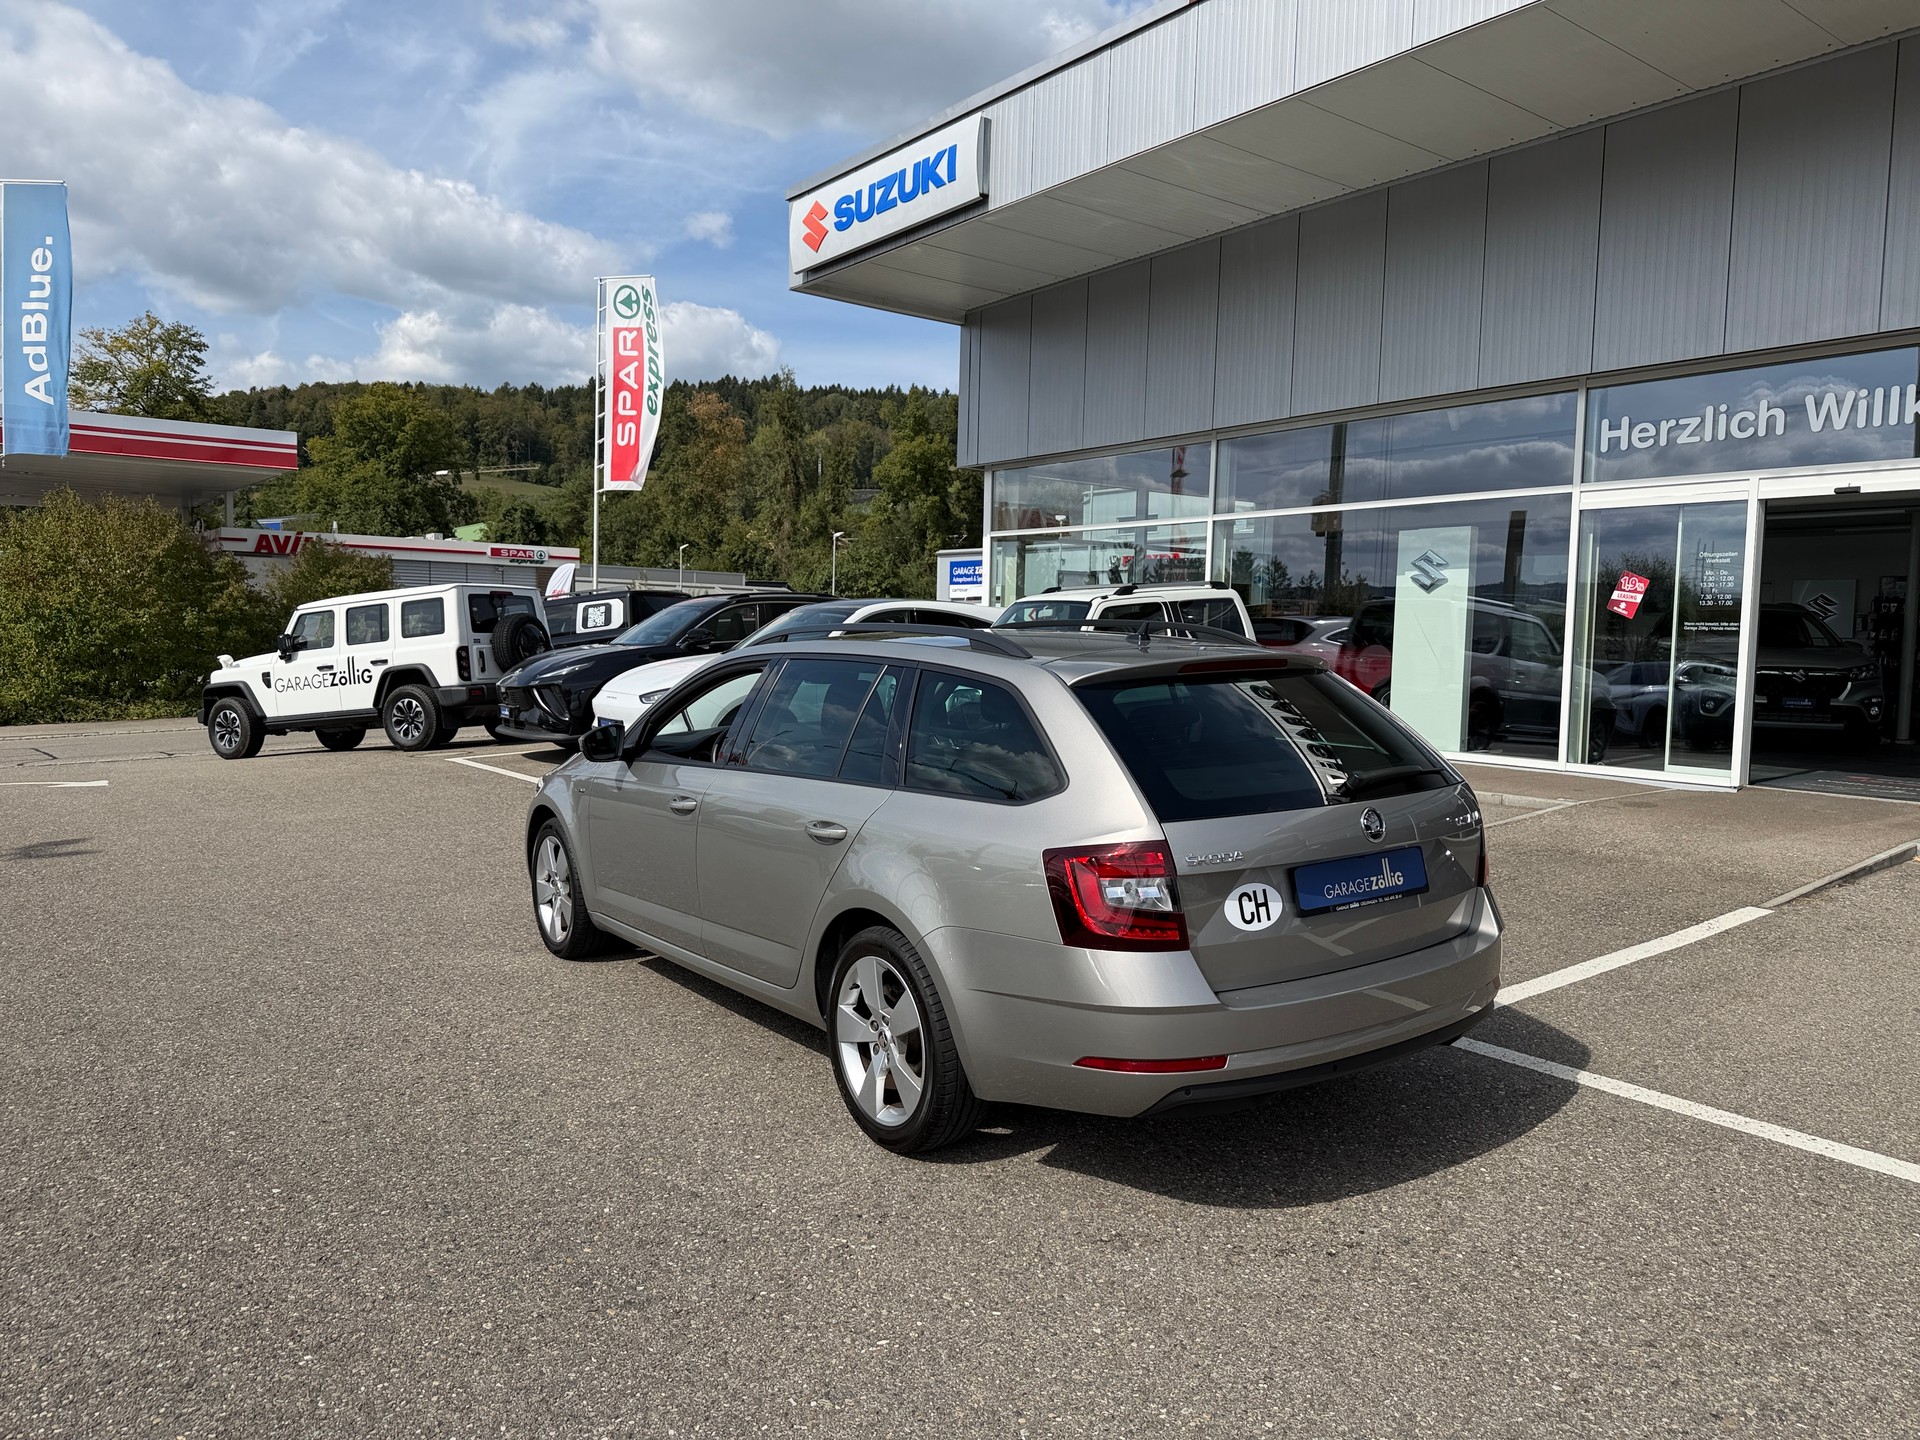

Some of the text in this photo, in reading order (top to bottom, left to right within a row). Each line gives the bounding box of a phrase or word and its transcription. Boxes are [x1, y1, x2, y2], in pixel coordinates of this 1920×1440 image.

[834, 144, 957, 232] SUZUKI
[642, 285, 663, 416] express
[616, 330, 639, 446] SPAR
[1600, 400, 1785, 453] Herzlich
[500, 549, 534, 558] SPAR
[952, 566, 974, 575] GARAGE
[1237, 888, 1272, 925] CH
